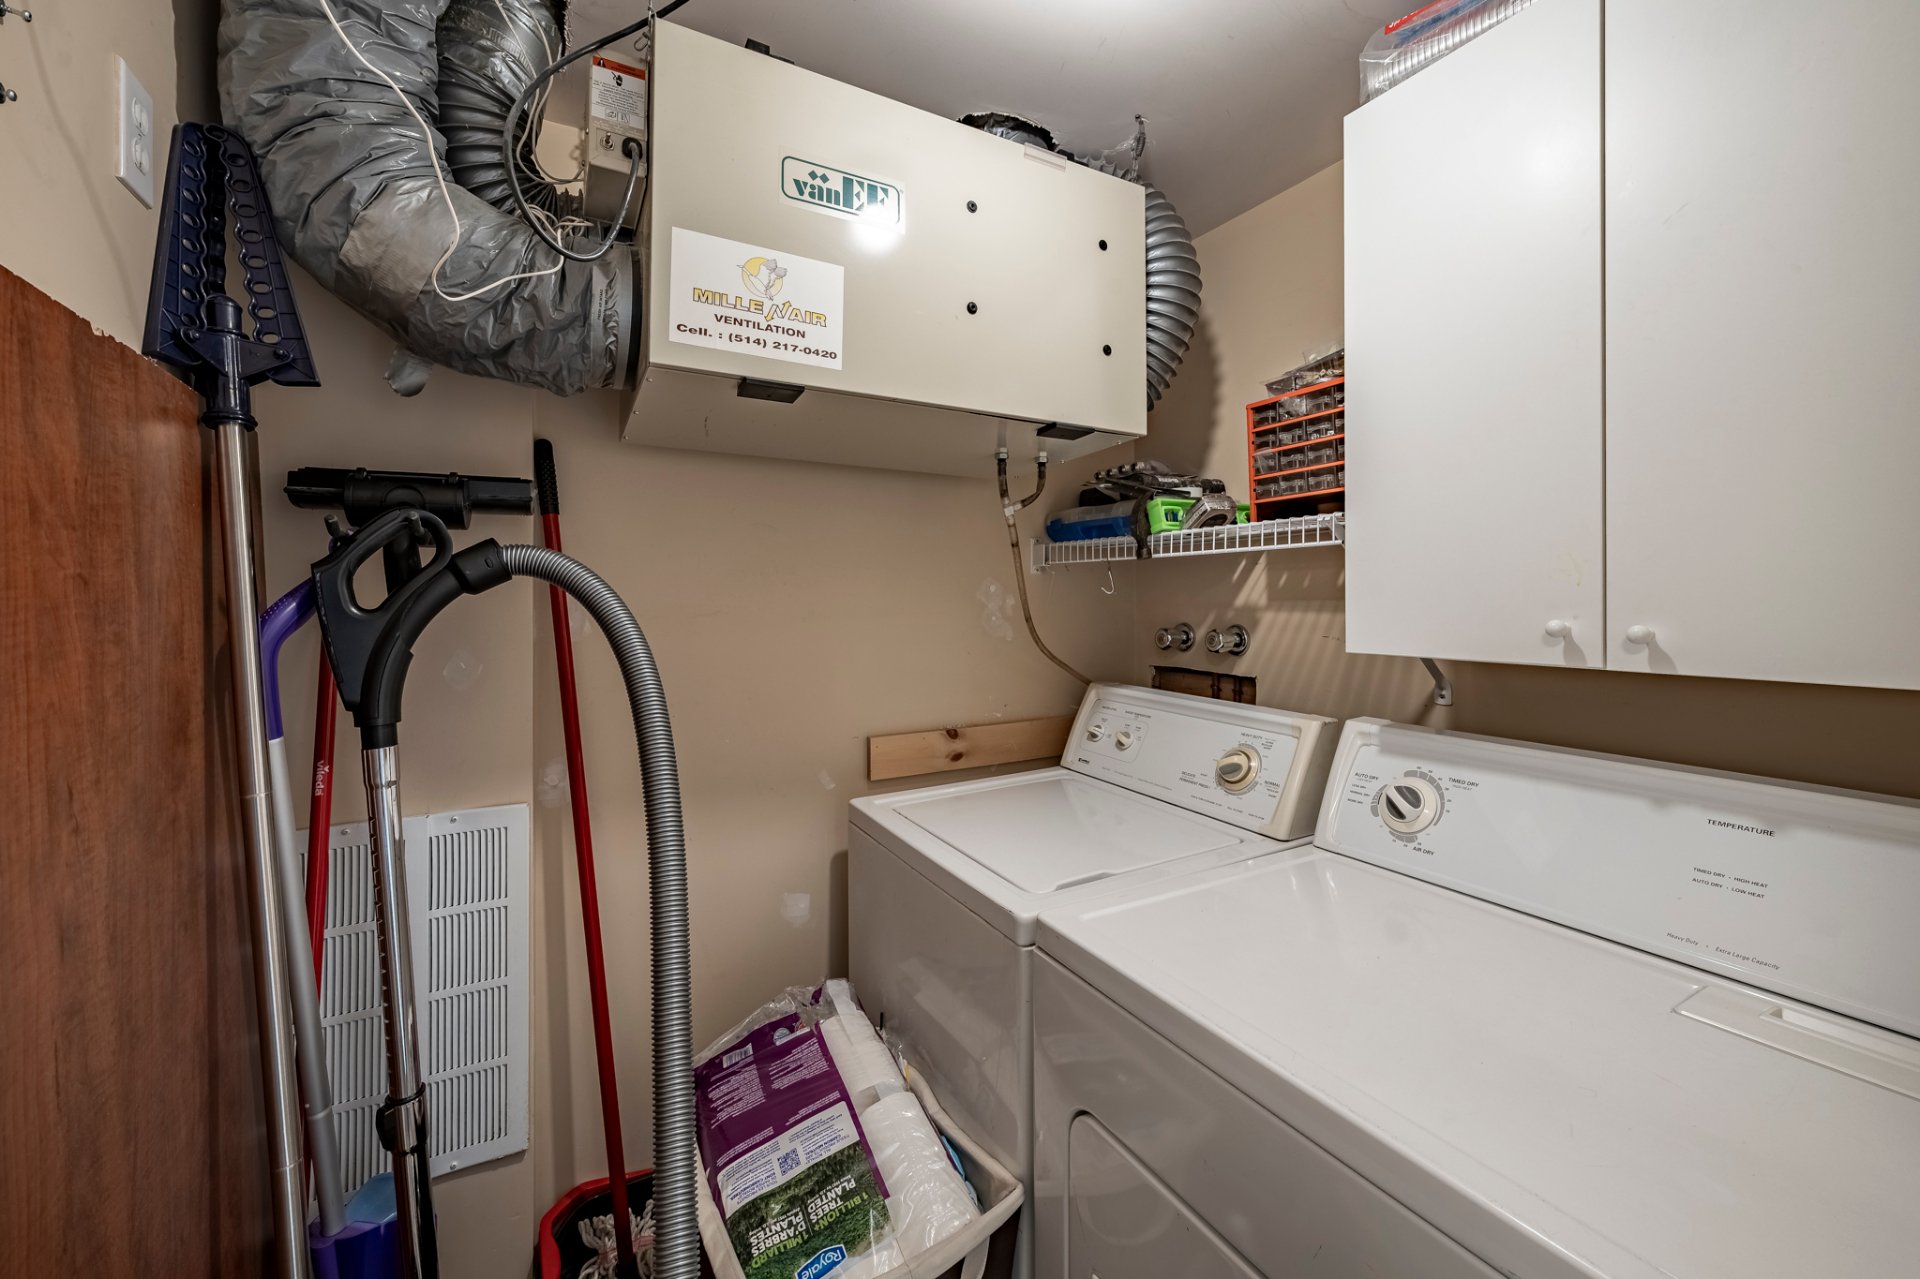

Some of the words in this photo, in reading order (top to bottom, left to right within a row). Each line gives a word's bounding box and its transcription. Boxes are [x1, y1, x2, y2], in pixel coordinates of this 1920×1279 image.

[714, 313, 806, 338] VENTILATION
[676, 323, 712, 338] Cell.
[728, 332, 767, 349] (514)
[772, 341, 838, 360] 217-0420
[314, 760, 326, 797] vileda
[1448, 777, 1466, 785] TIMED
[1466, 780, 1480, 788] DRY
[1706, 818, 1776, 837] TEMPERATURE
[1422, 848, 1435, 856] DRY
[1692, 877, 1710, 885] AUTO
[1731, 887, 1747, 895] LOW
[1747, 891, 1765, 899] HEAT
[1693, 867, 1712, 875] TIMED
[1733, 876, 1750, 884] HIGH
[1750, 880, 1769, 889] HEAT
[1666, 932, 1685, 942] Heavy
[1685, 937, 1699, 946] Duty
[1715, 946, 1732, 956] Extra
[1731, 951, 1750, 961] Large
[1751, 957, 1781, 970] Capacity
[808, 1178, 856, 1213] PLANTED
[809, 1196, 844, 1223] TREES
[862, 1191, 869, 1200] 1
[814, 1195, 862, 1231] BILLION+
[751, 1221, 807, 1257] D'ARBRES
[751, 1236, 803, 1268] MILLIARD
[801, 1249, 842, 1279] Royale
